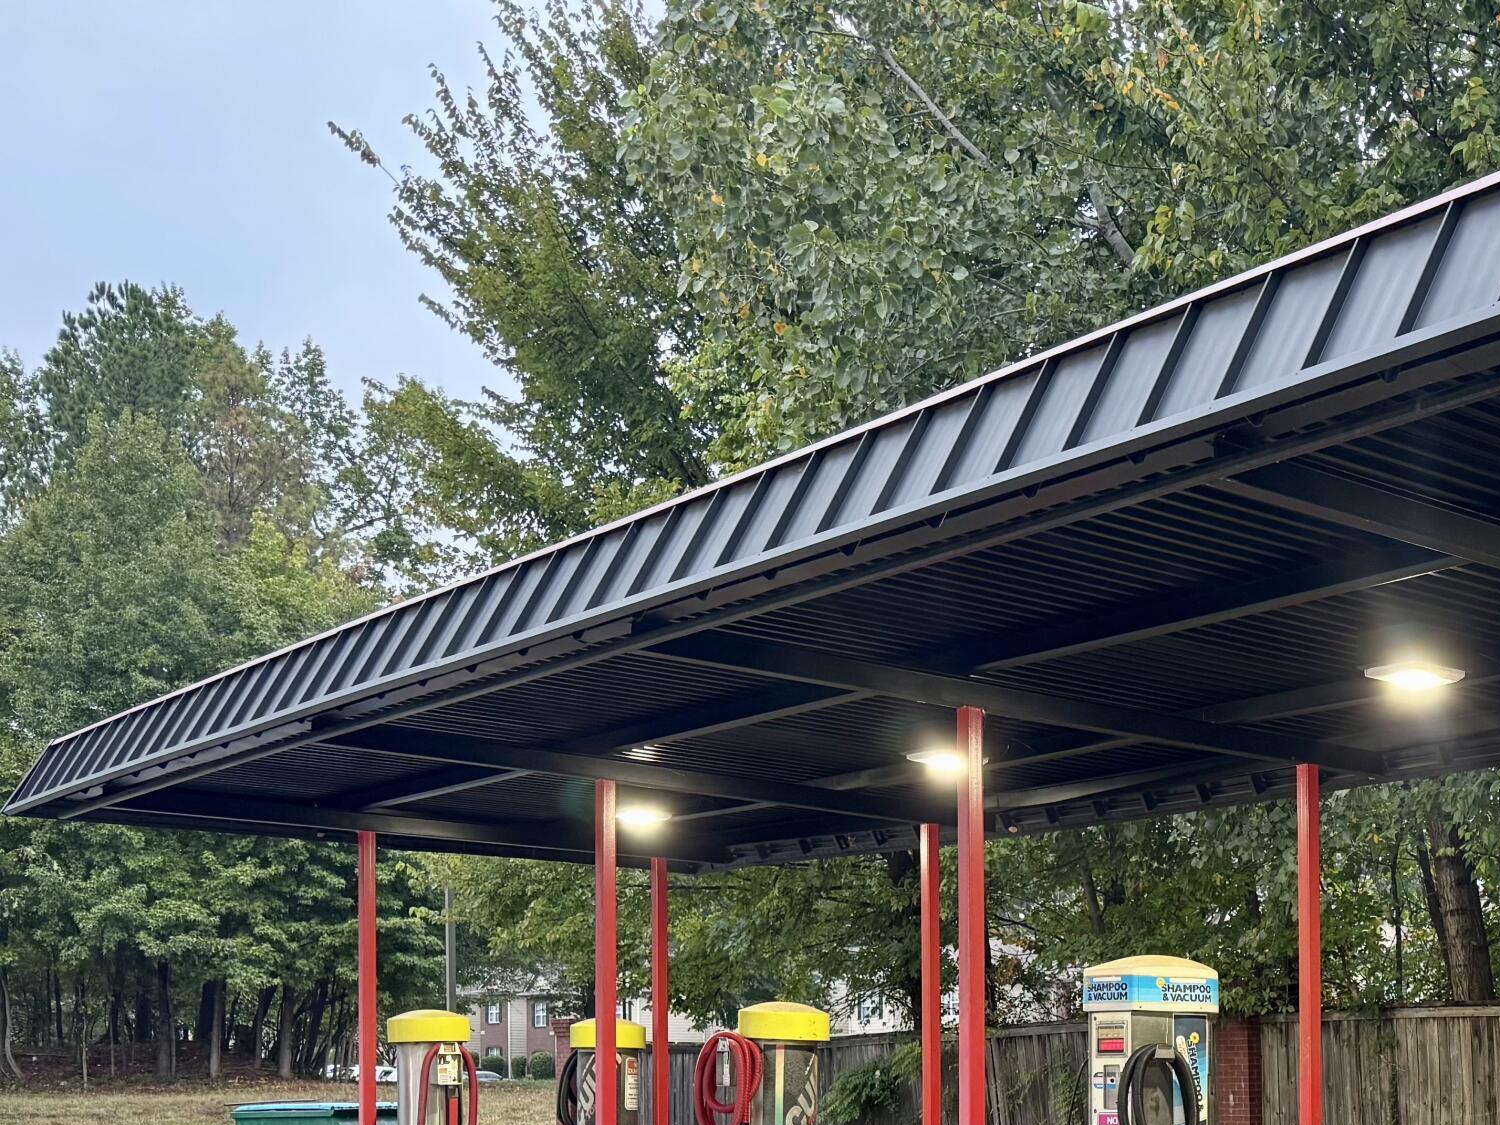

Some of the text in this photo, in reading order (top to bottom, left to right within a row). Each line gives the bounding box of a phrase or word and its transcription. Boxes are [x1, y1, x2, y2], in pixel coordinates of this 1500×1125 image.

[1088, 983, 1128, 992] SHAMPOO
[1161, 983, 1211, 994] SHAMPOO
[1093, 992, 1128, 1001] VACUUM
[1162, 993, 1212, 1003] & VACUUM
[1107, 1116, 1119, 1125] NO
